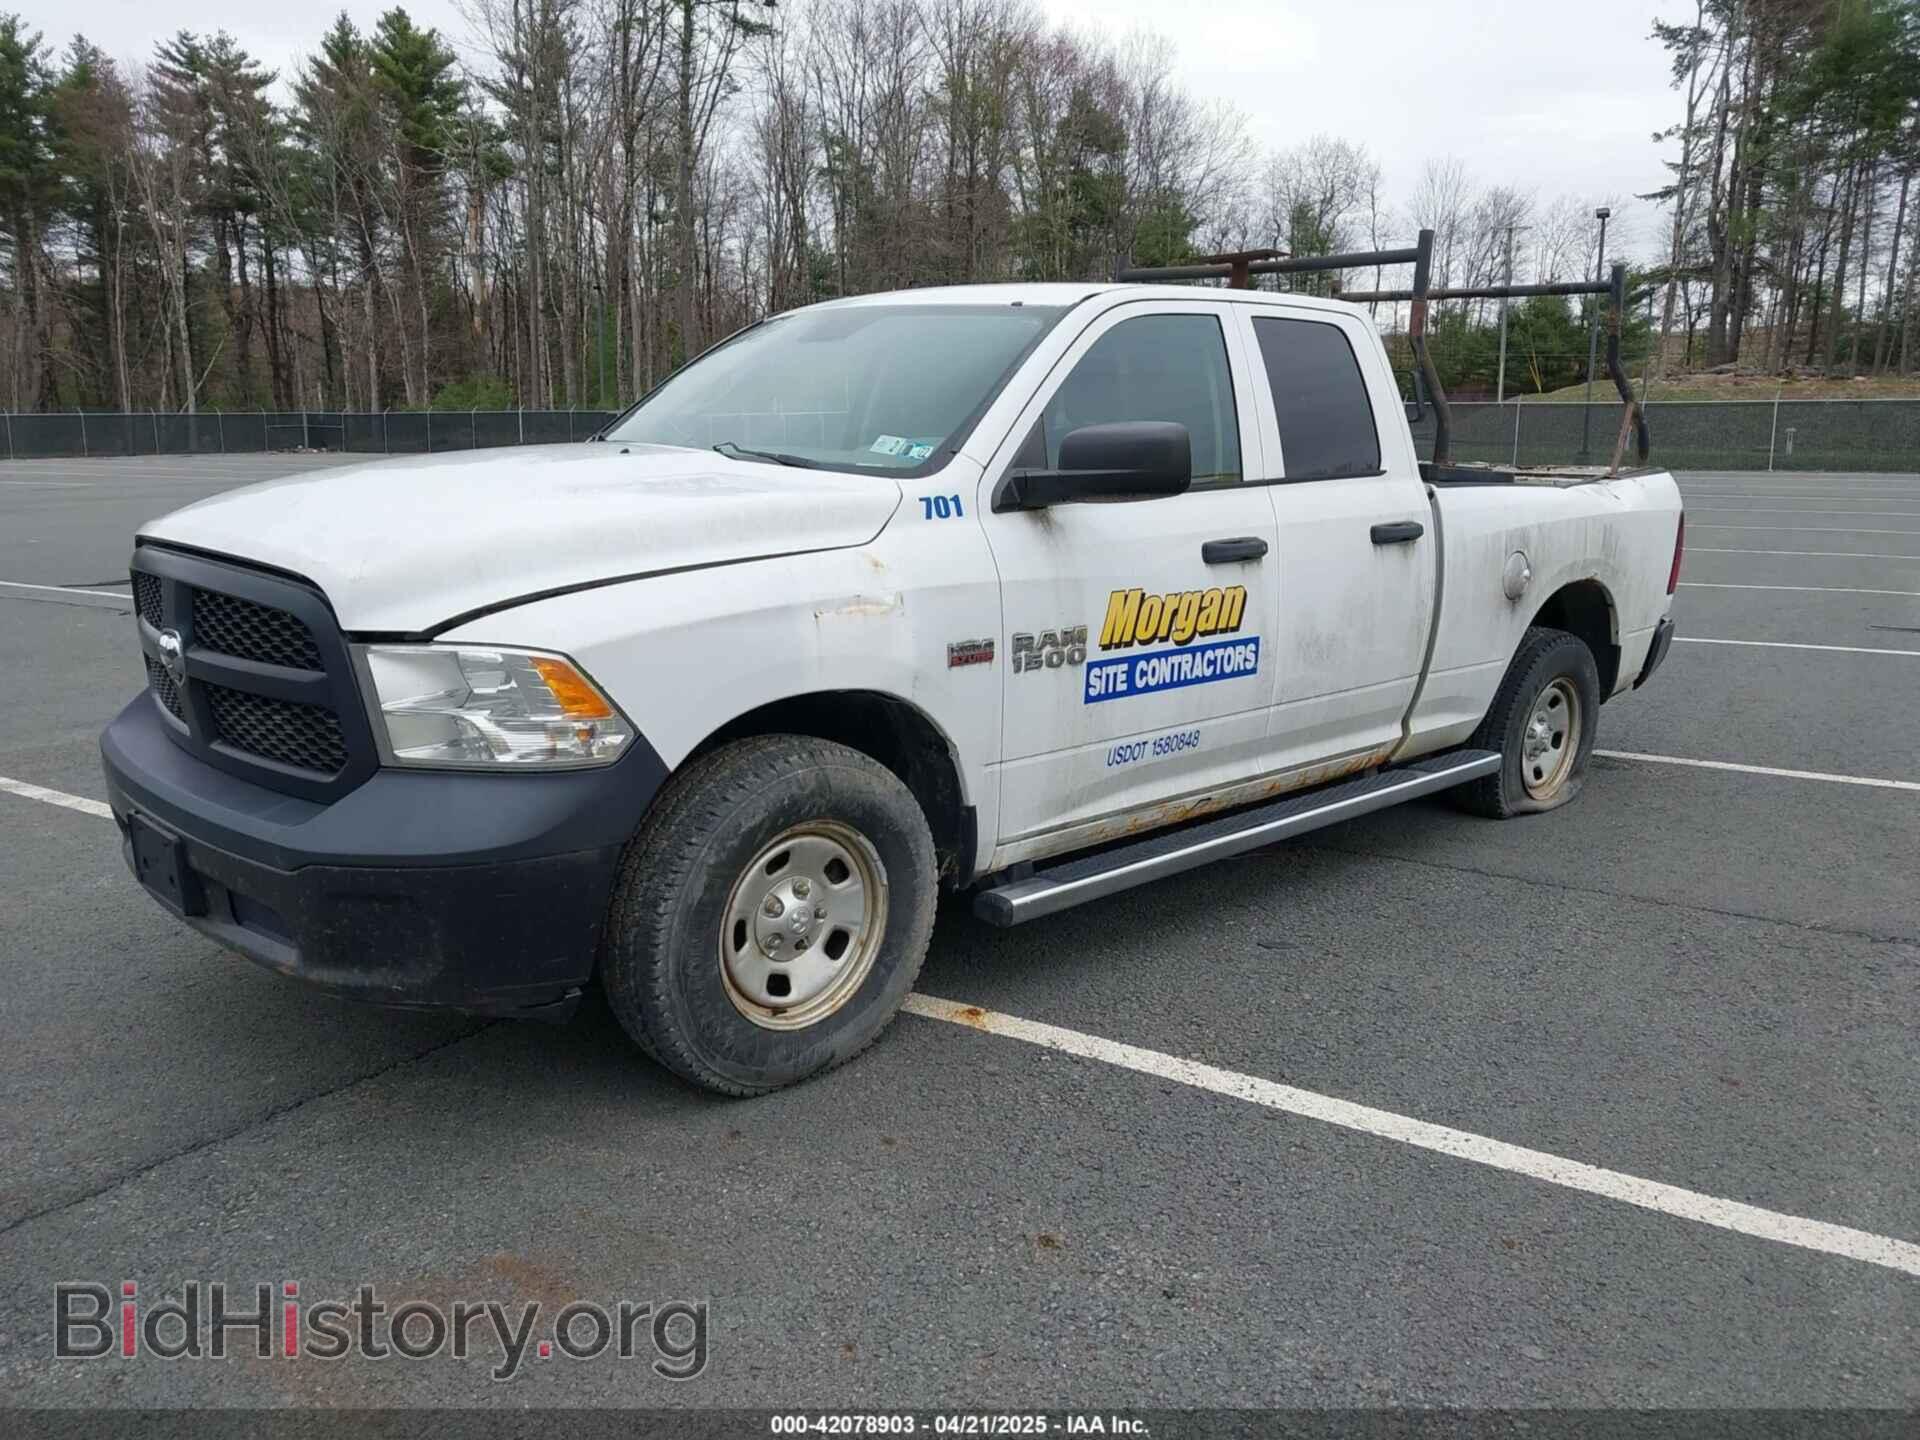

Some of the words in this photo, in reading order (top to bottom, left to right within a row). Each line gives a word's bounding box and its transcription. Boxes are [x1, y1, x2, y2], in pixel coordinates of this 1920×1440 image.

[919, 495, 963, 520] 701
[1099, 584, 1247, 651] Morgan
[1012, 645, 1088, 674] 1500
[1088, 662, 1129, 697] SITE
[1135, 643, 1258, 689] CONTRACTORS
[1107, 741, 1148, 767] USDOT
[1152, 729, 1201, 756] 1580848
